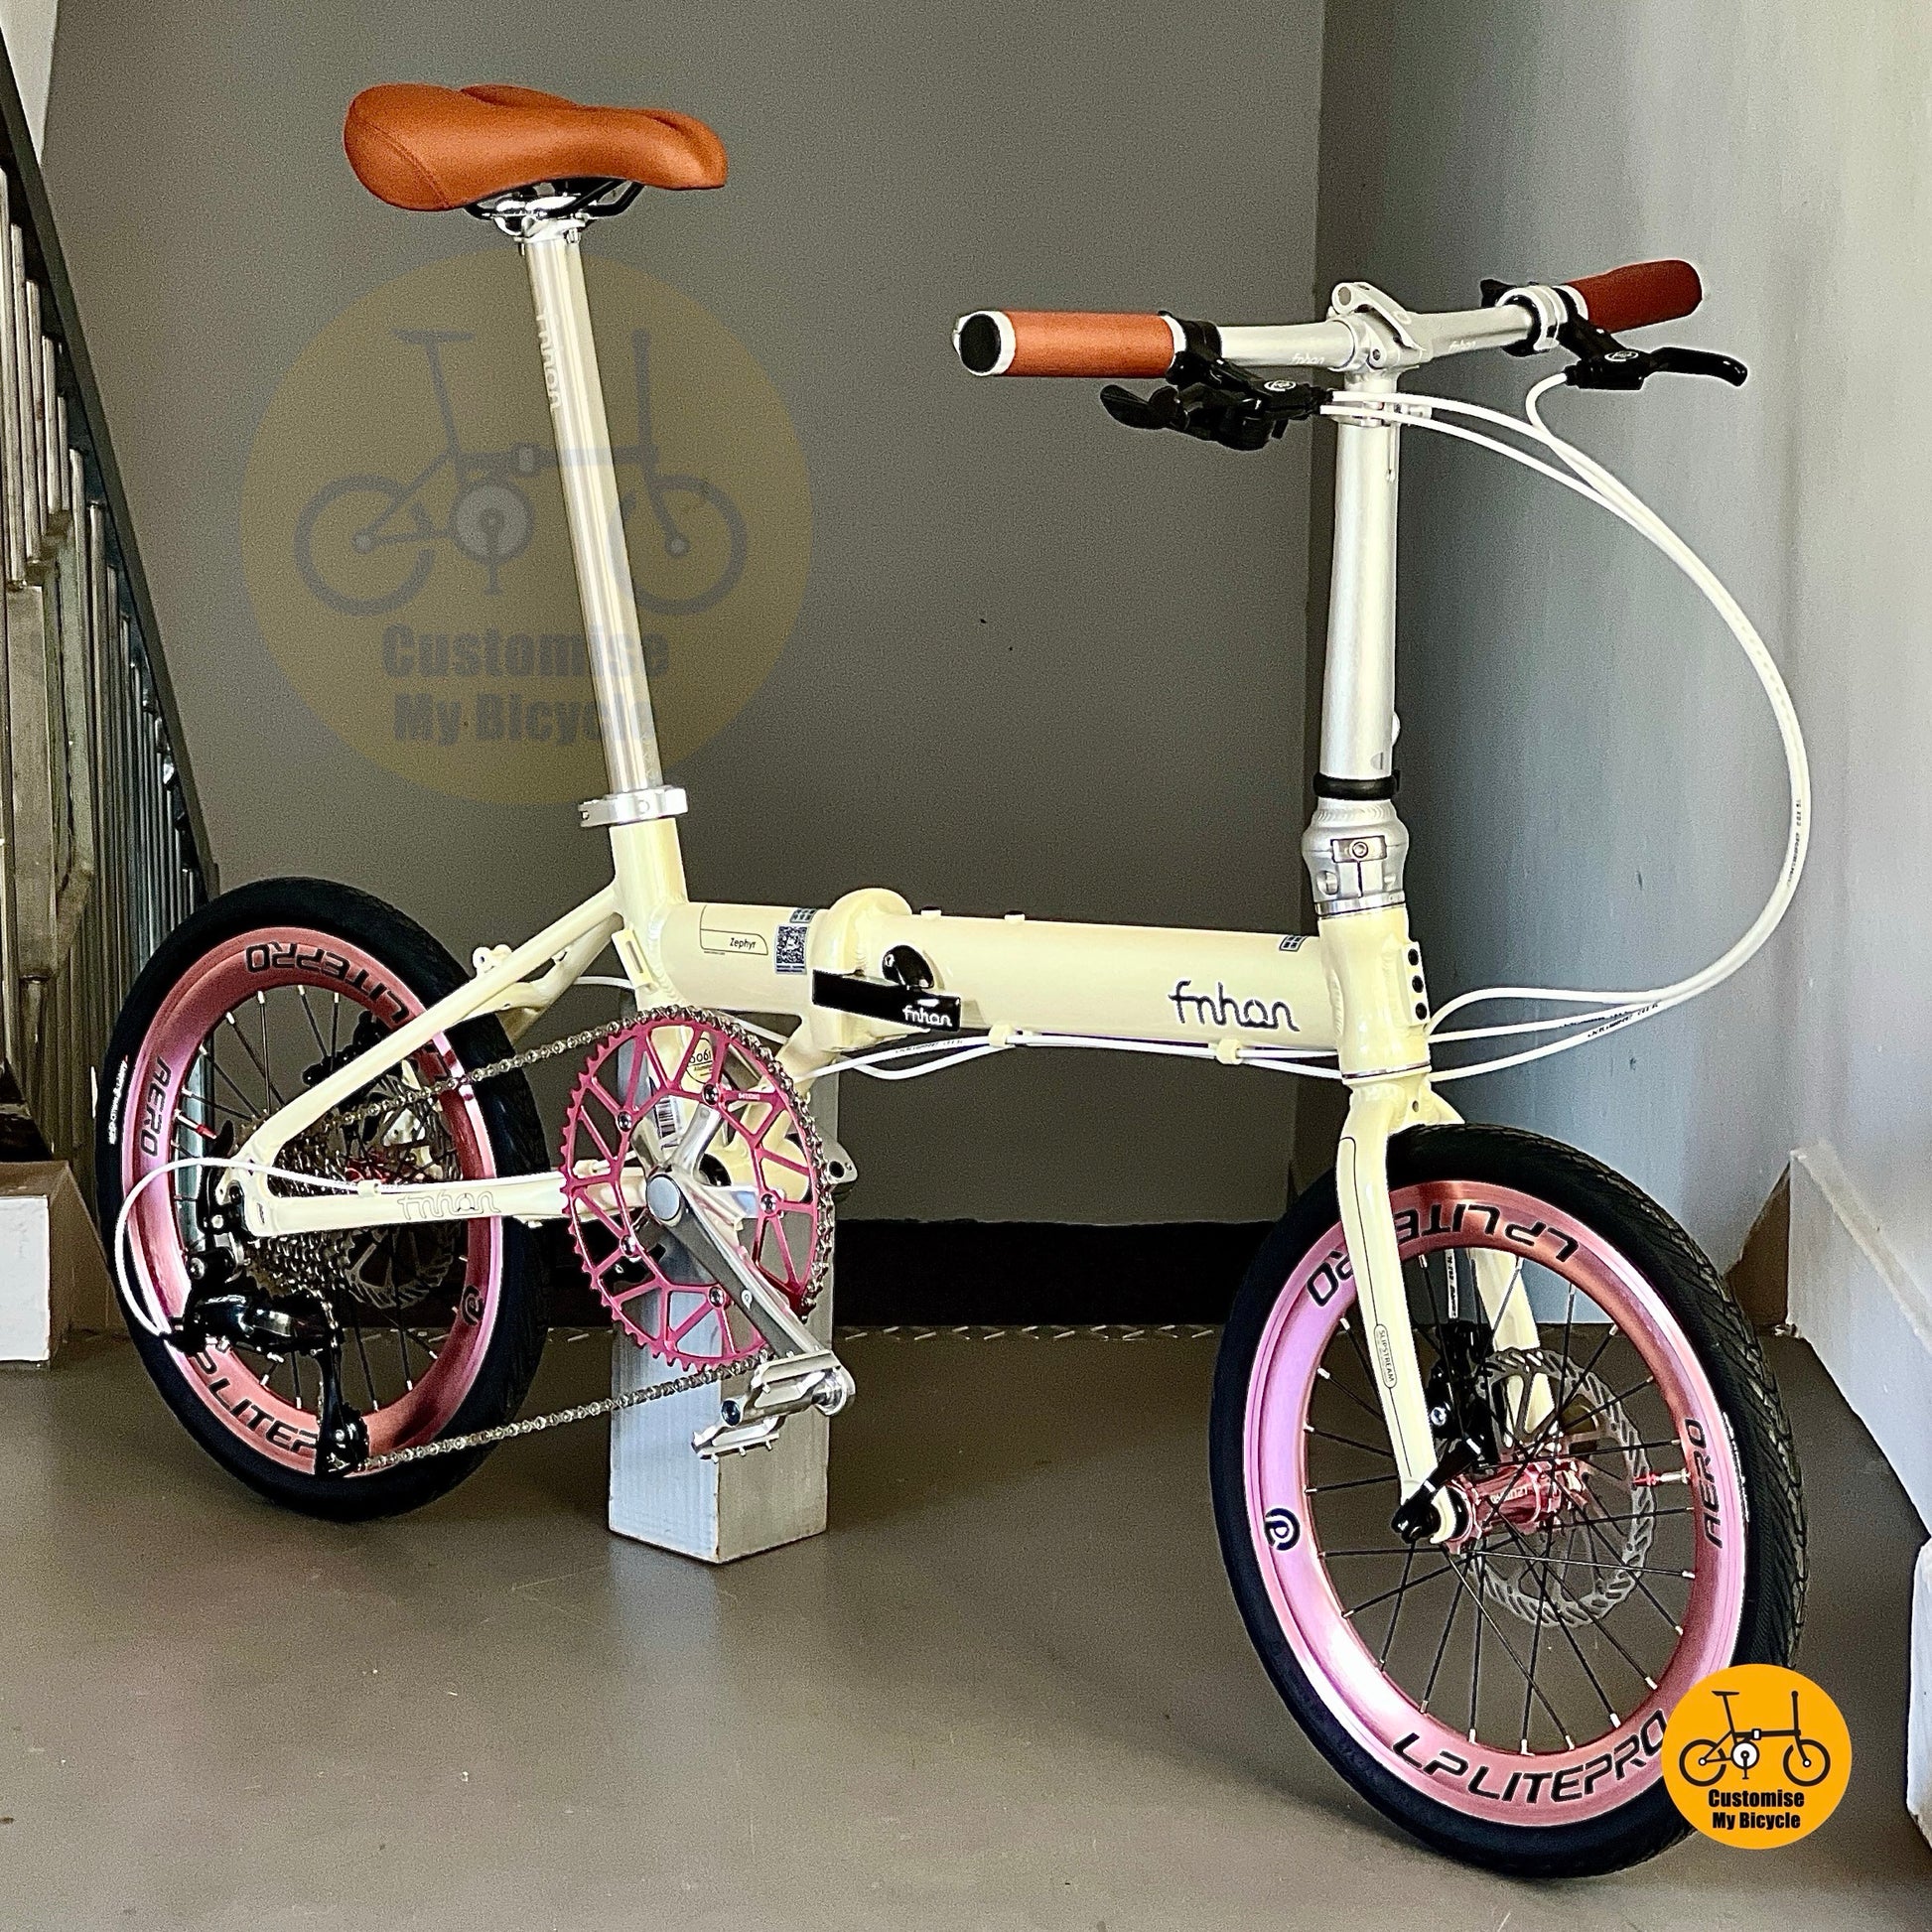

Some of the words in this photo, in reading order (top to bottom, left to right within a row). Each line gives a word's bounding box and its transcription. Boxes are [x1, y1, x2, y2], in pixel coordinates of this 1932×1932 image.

[1292, 353, 1325, 365] fnhan
[730, 937, 756, 950] Zephyr
[901, 1004, 952, 1028] fnhan
[1168, 979, 1301, 1032] fnhan
[140, 1056, 171, 1157] AERO
[1379, 1329, 1395, 1381] SLIPSTREAM
[1685, 1418, 1723, 1549] AERO
